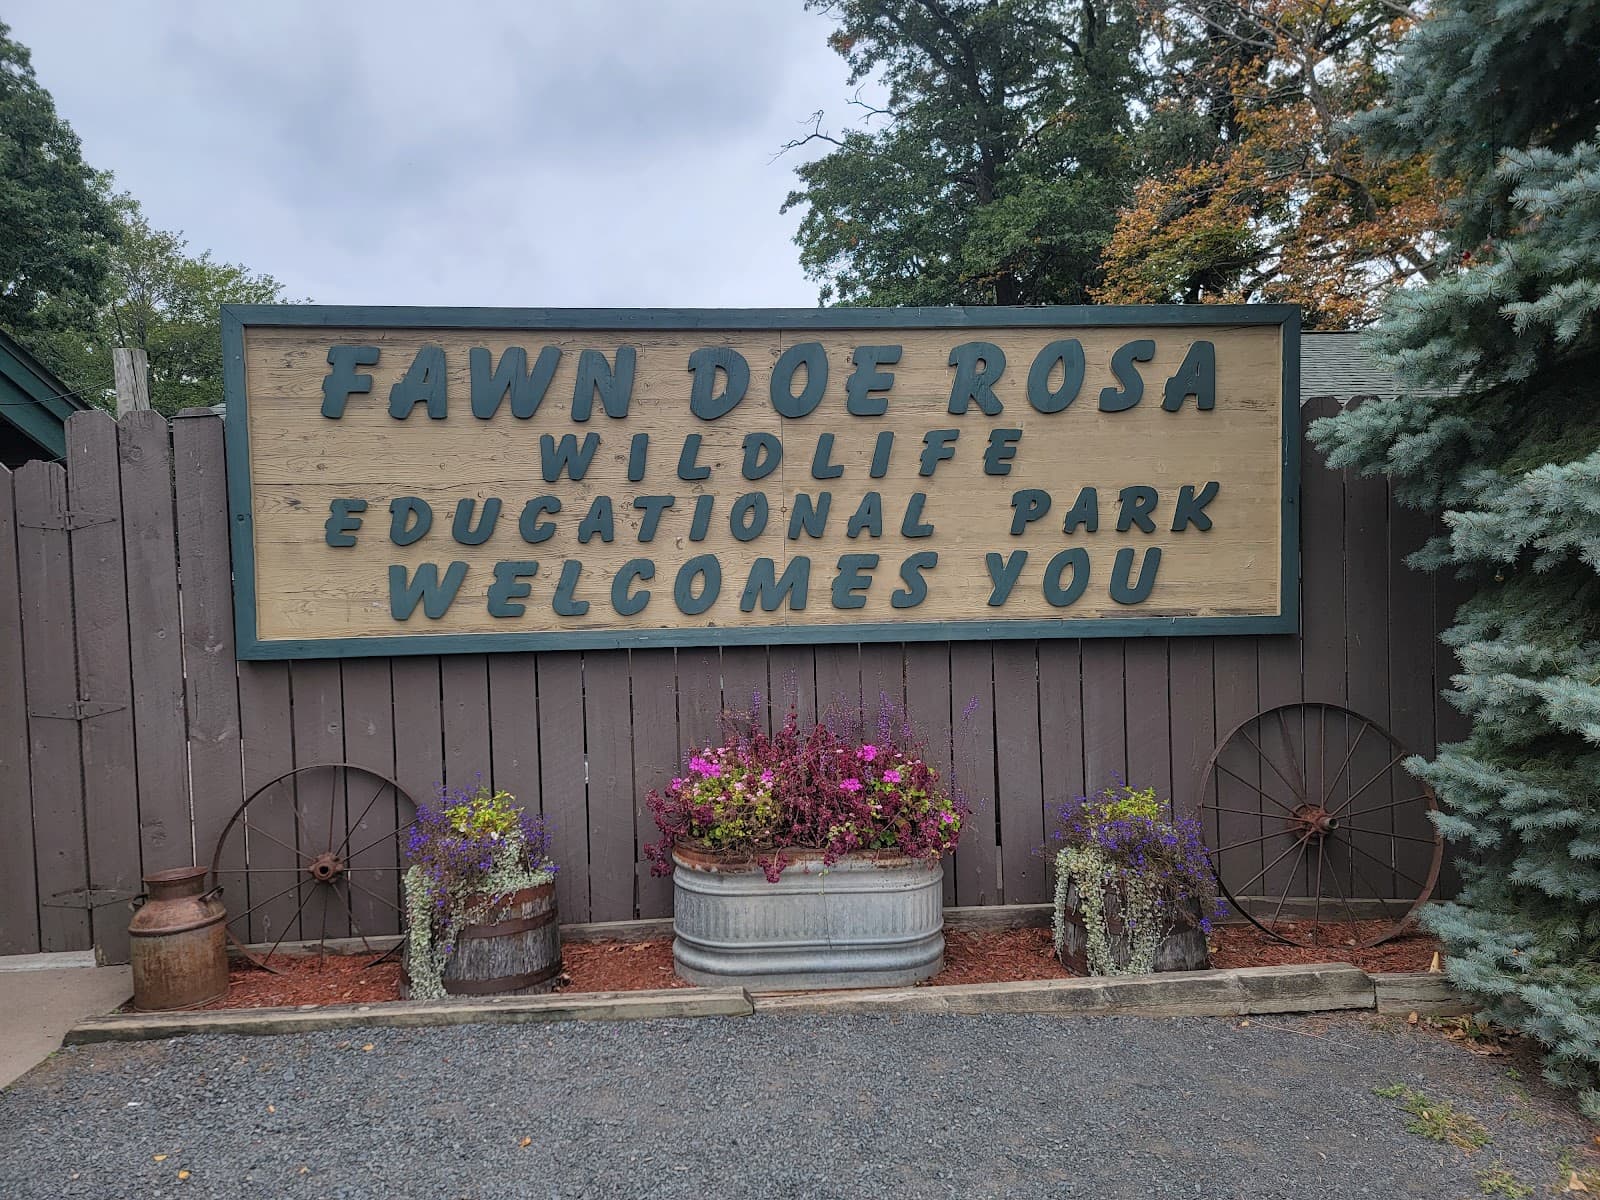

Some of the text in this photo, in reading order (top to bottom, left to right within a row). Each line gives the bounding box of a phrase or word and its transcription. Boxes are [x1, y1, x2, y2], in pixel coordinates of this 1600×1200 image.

[320, 338, 1217, 422] FAWN DOE ROSA
[540, 429, 1022, 483] WILDLIFE
[325, 481, 1220, 547] EDUCATIONAL PARK
[388, 547, 1162, 621] WELCOMES YOU
